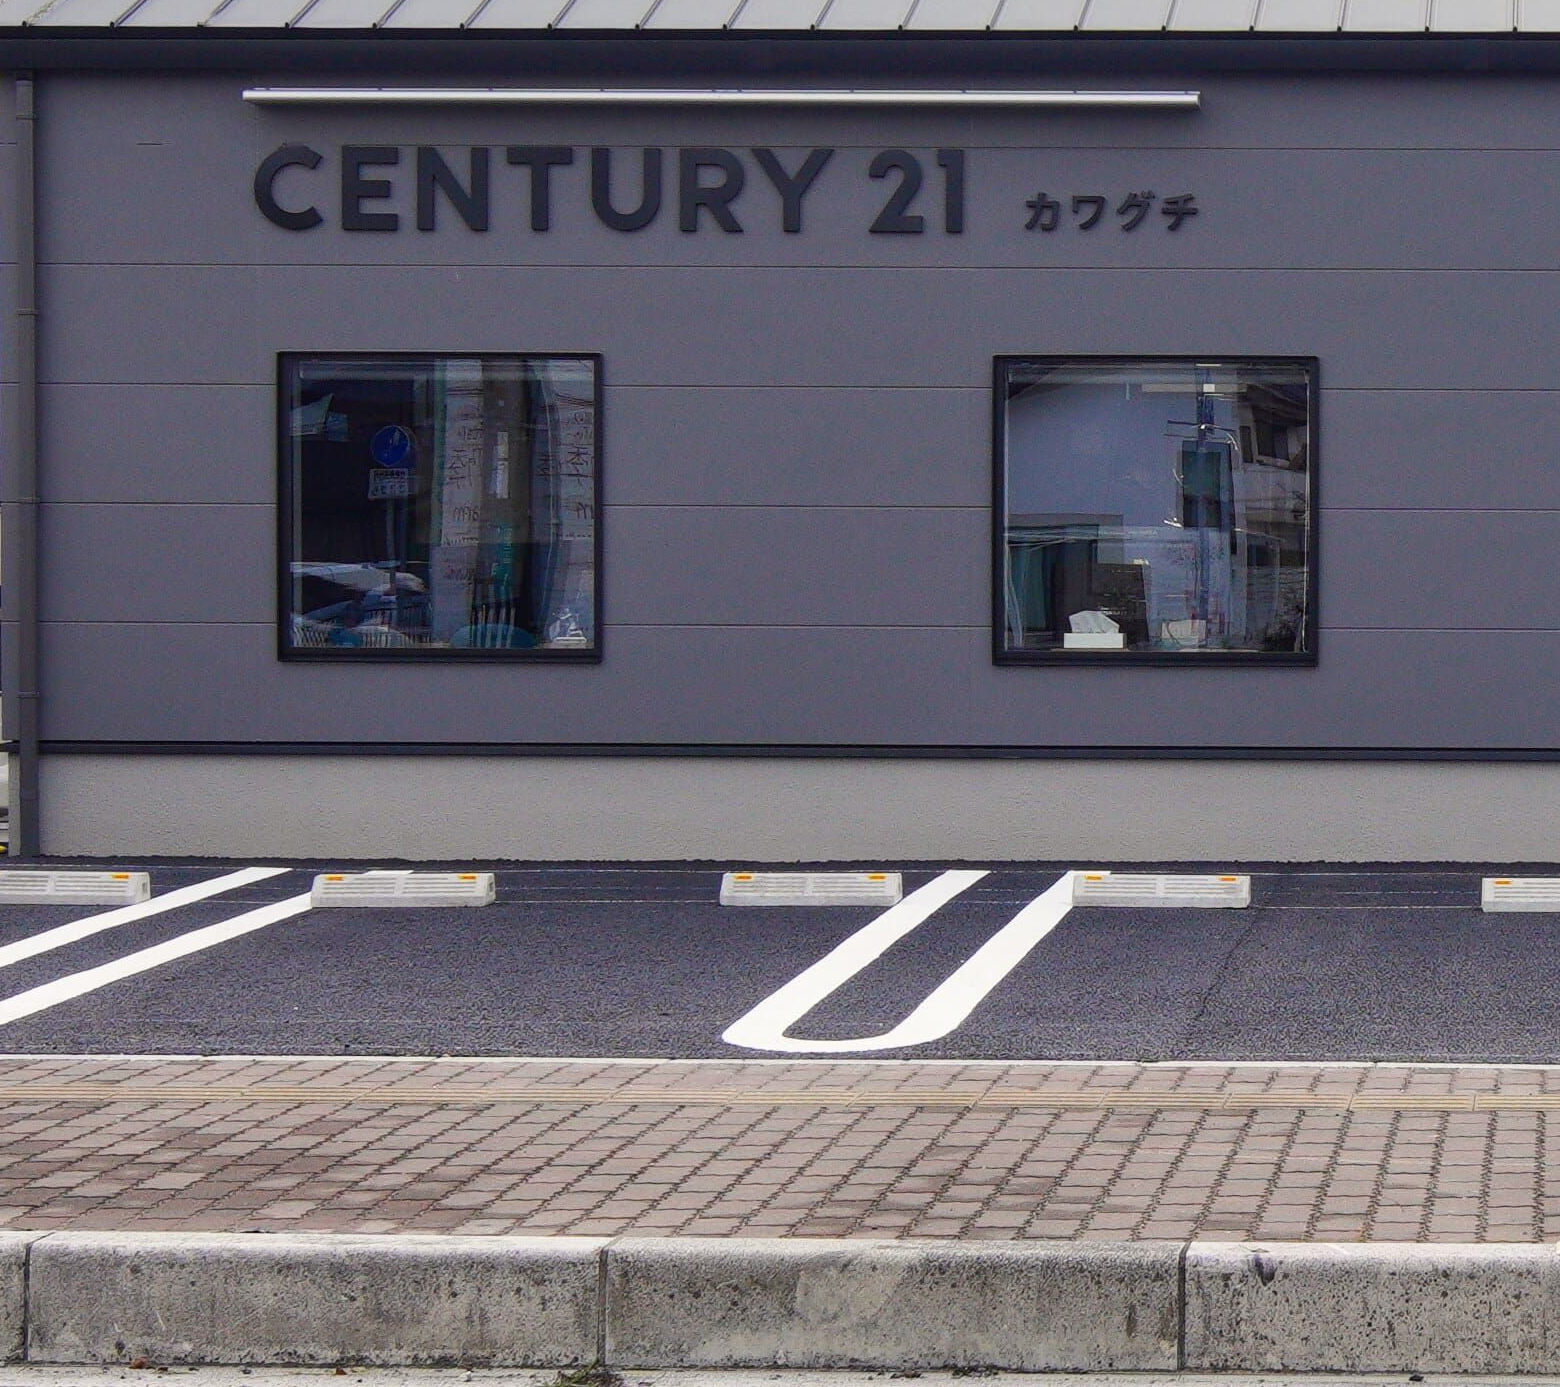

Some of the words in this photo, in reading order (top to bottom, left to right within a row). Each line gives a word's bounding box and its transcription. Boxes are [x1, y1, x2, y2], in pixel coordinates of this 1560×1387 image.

[252, 142, 835, 233] CENTURY
[868, 146, 966, 234] 21
[1024, 190, 1199, 231] カワグチ
